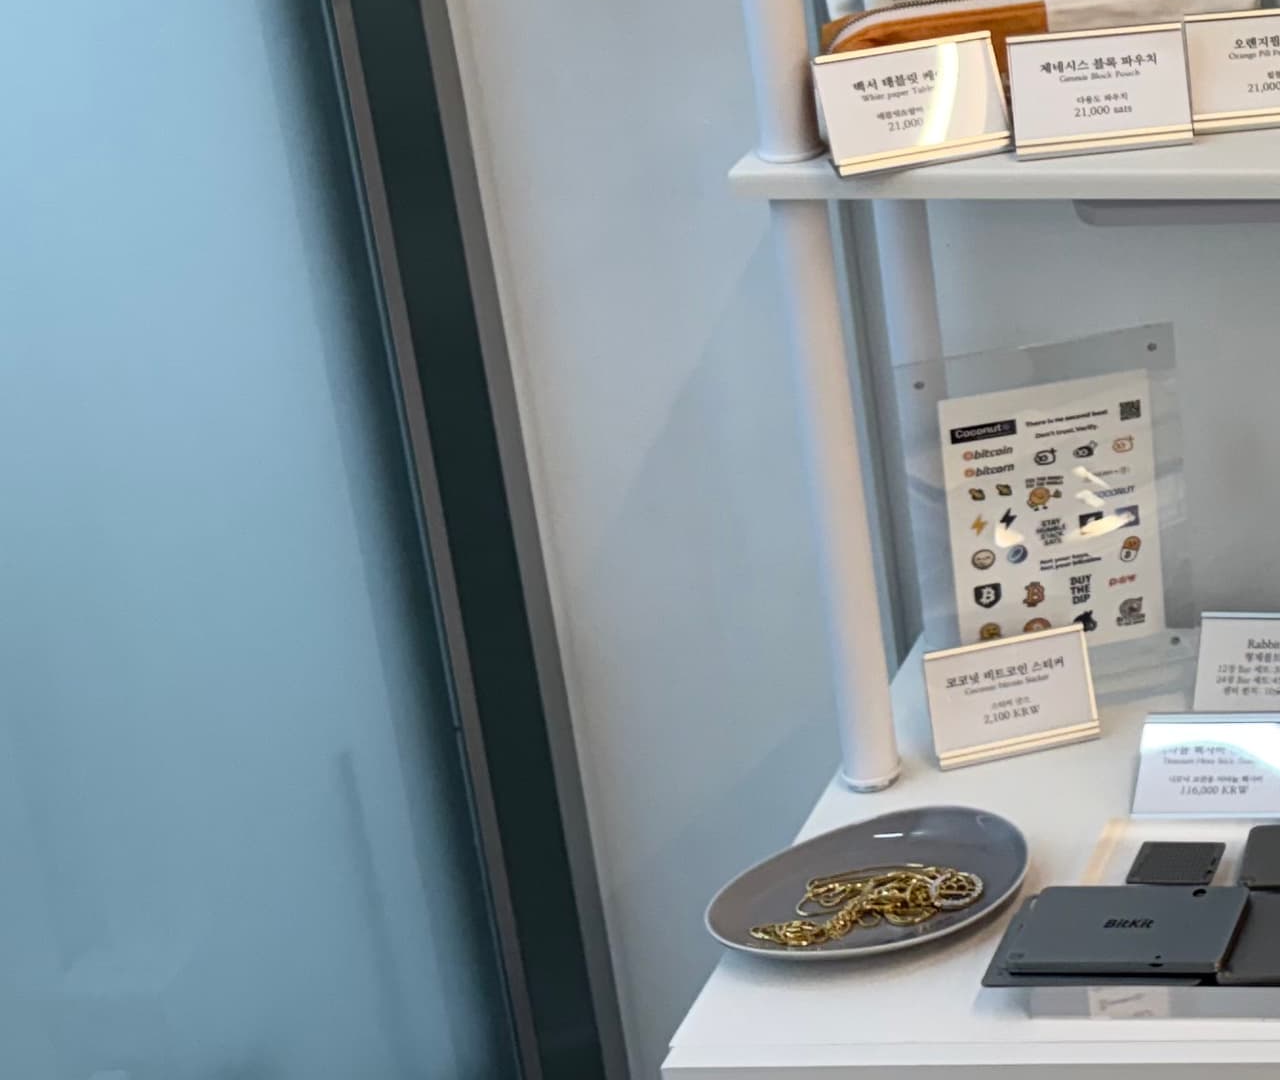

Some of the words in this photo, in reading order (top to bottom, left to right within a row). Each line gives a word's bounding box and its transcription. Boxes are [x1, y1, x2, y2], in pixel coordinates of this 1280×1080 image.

[1234, 35, 1280, 49] 오렌지필
[1228, 52, 1256, 60] Orange
[1040, 60, 1089, 74] 제네시스
[1093, 57, 1117, 70] 블록
[1120, 52, 1157, 67] 파우치
[1091, 71, 1112, 80] Block
[1115, 69, 1141, 78] Pouch
[852, 78, 878, 92] 백서
[881, 72, 919, 88] 태블릿
[1074, 105, 1110, 118] 21,000
[1113, 105, 1132, 114] sats
[955, 424, 1001, 440] Coconut
[974, 446, 1013, 460] bitcoin
[975, 463, 1015, 478] bitcorn
[1041, 518, 1061, 527] STAY
[1070, 573, 1092, 586] BUY
[1070, 584, 1091, 596] THE
[1072, 593, 1091, 605] DIP
[1247, 639, 1280, 649] Rabbit
[945, 672, 980, 689] 코코넛
[983, 662, 1029, 681] 비트코인
[1031, 656, 1065, 672] 스티커
[983, 710, 1011, 725] 2,100
[1012, 704, 1041, 718] KRW
[1222, 785, 1249, 794] KRW
[1103, 918, 1154, 930] BitKit
